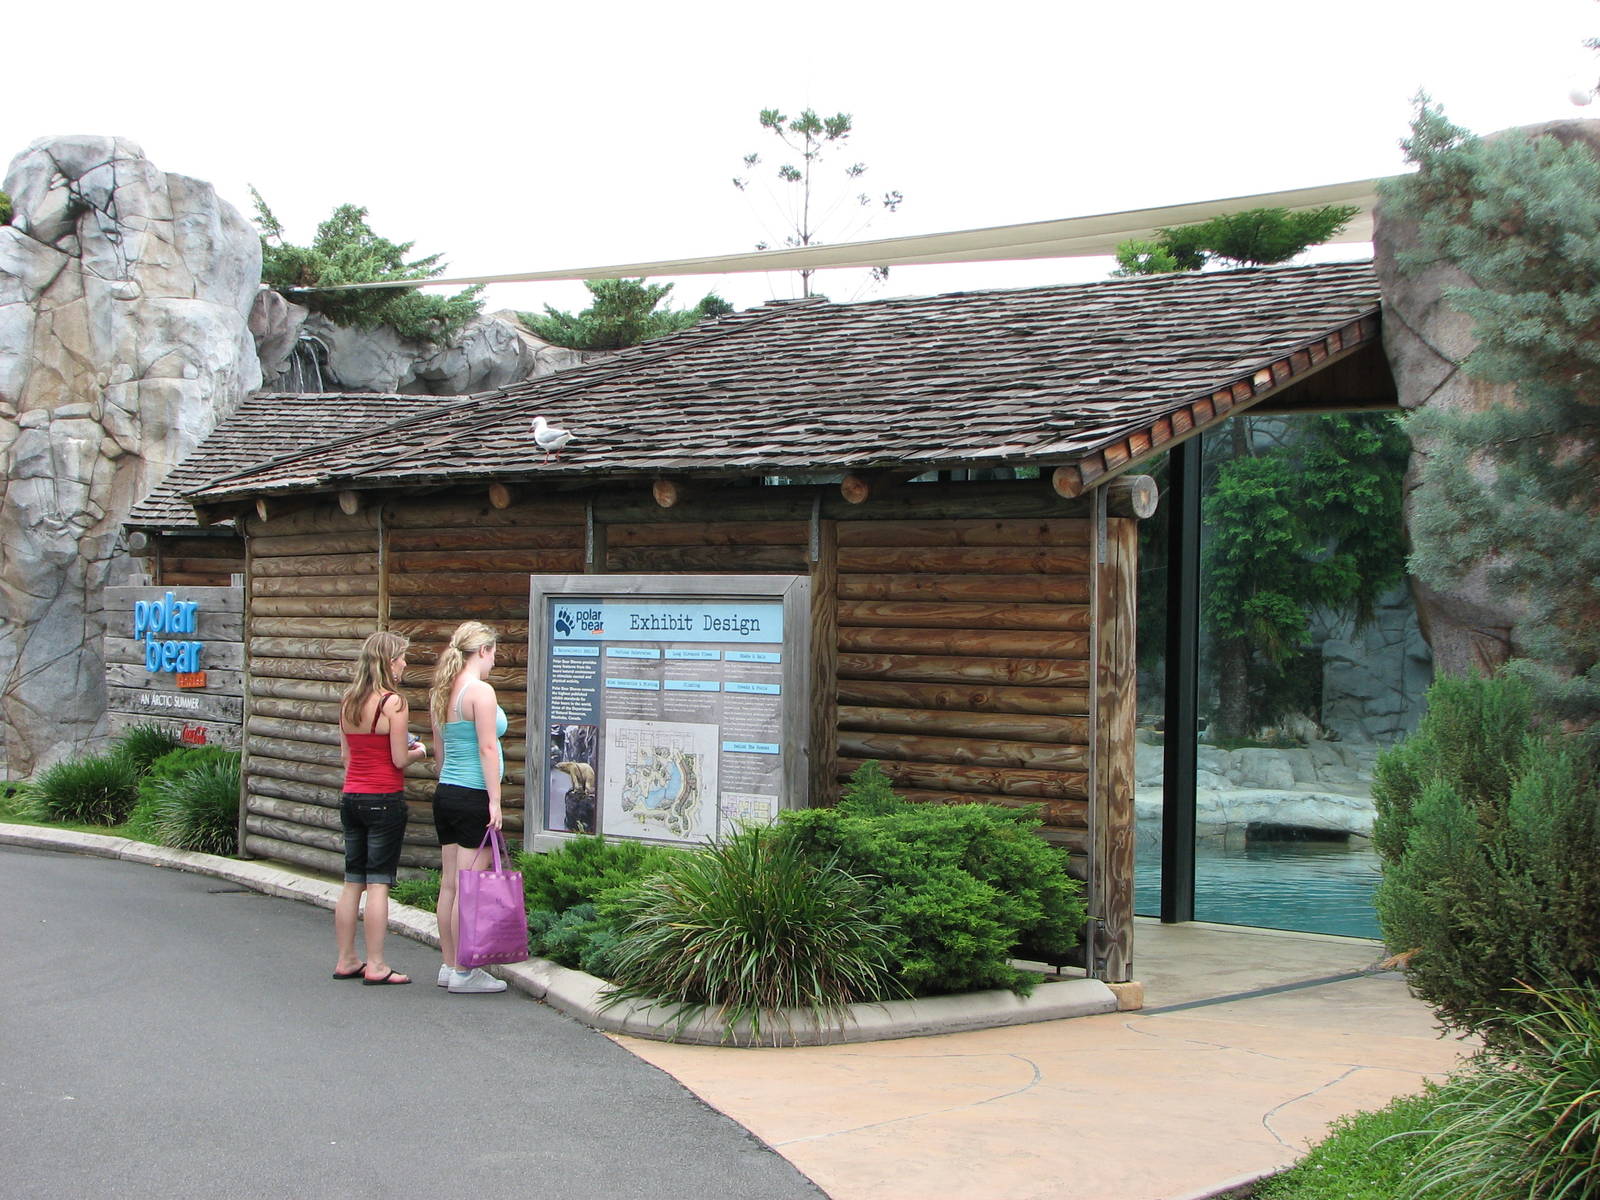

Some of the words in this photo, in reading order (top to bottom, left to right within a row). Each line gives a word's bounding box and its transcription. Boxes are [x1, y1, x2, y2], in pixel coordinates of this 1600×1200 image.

[134, 592, 198, 640] polar
[576, 609, 601, 623] polar
[630, 614, 693, 631] Exhibit
[703, 615, 760, 635] Design
[581, 620, 604, 631] bear
[146, 632, 203, 673] bear
[140, 695, 150, 704] AN
[151, 695, 172, 706] ARCTIC
[173, 697, 199, 709] SUMMER
